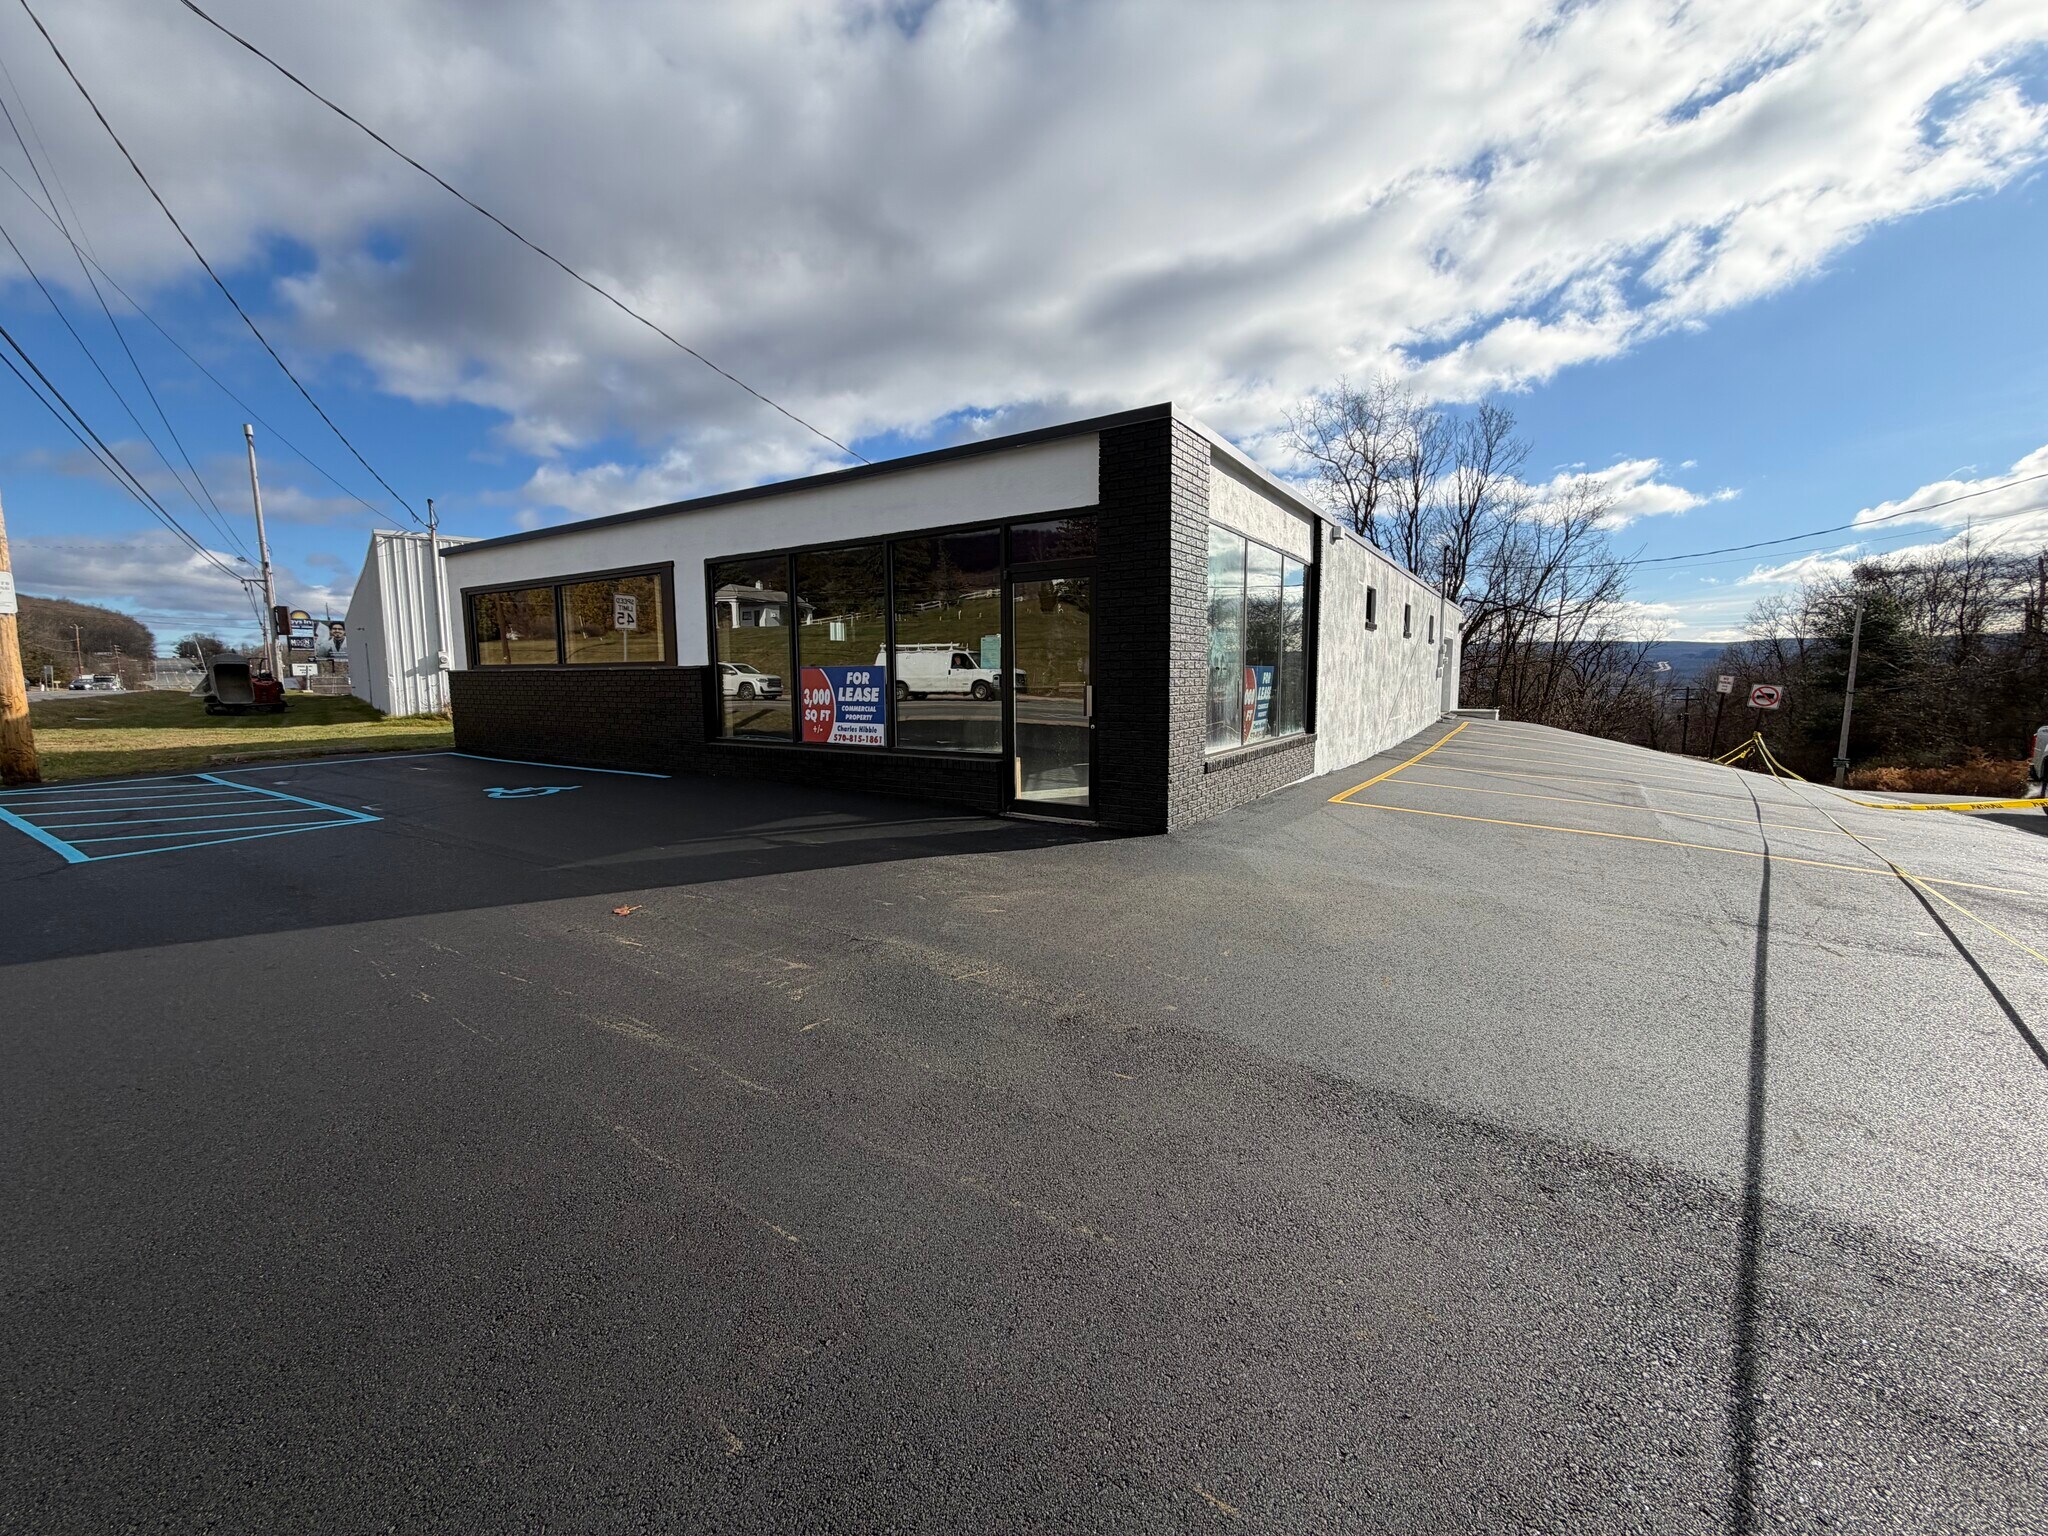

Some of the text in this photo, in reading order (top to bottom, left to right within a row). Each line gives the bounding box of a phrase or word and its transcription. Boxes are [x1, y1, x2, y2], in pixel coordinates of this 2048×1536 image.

[846, 672, 870, 685] FOR
[804, 688, 831, 707] 3,000
[838, 687, 880, 702] LEASE
[805, 709, 831, 722] SQ FT
[841, 705, 877, 713] COMMERCIAL
[845, 713, 873, 721] PROPERTY
[833, 734, 882, 743] 570-815-1861
